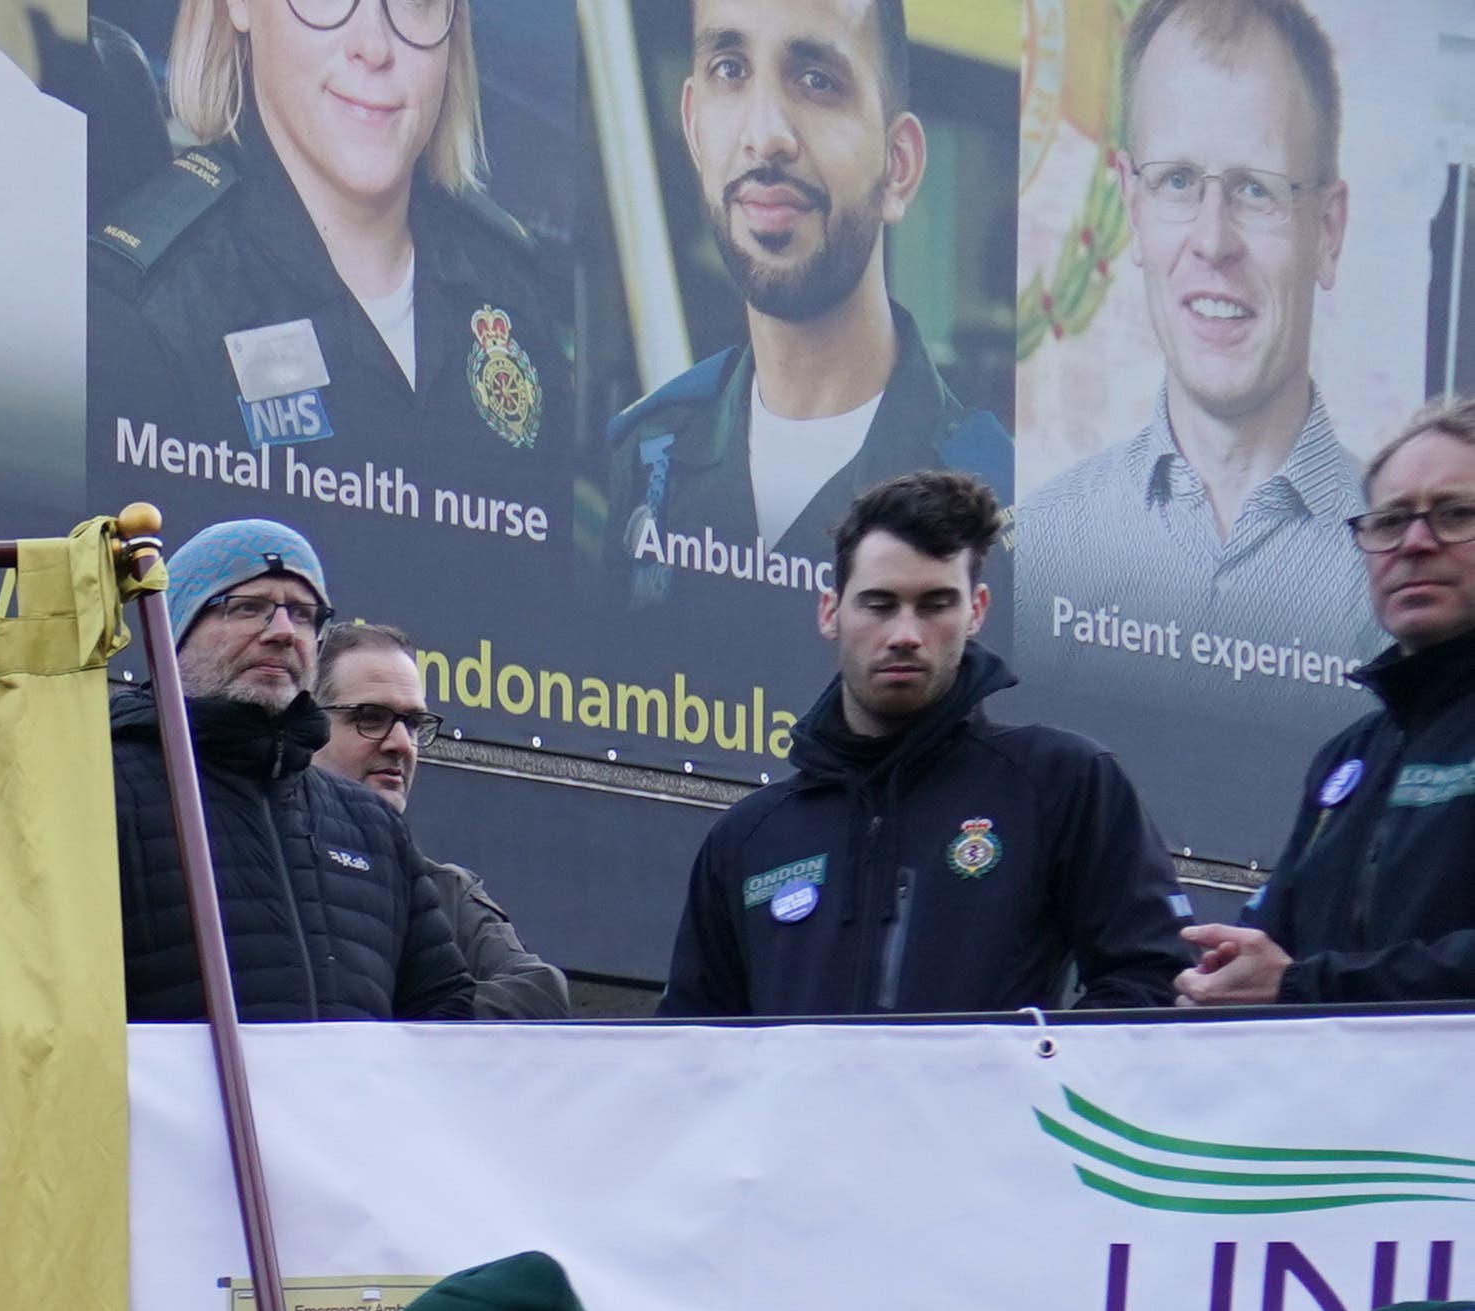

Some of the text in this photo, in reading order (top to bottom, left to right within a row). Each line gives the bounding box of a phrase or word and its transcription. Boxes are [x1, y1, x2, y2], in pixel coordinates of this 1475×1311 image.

[104, 225, 141, 248] NURSE
[250, 396, 321, 440] NHS
[116, 418, 548, 541] Mental health nurse
[1053, 598, 1181, 660] Patient
